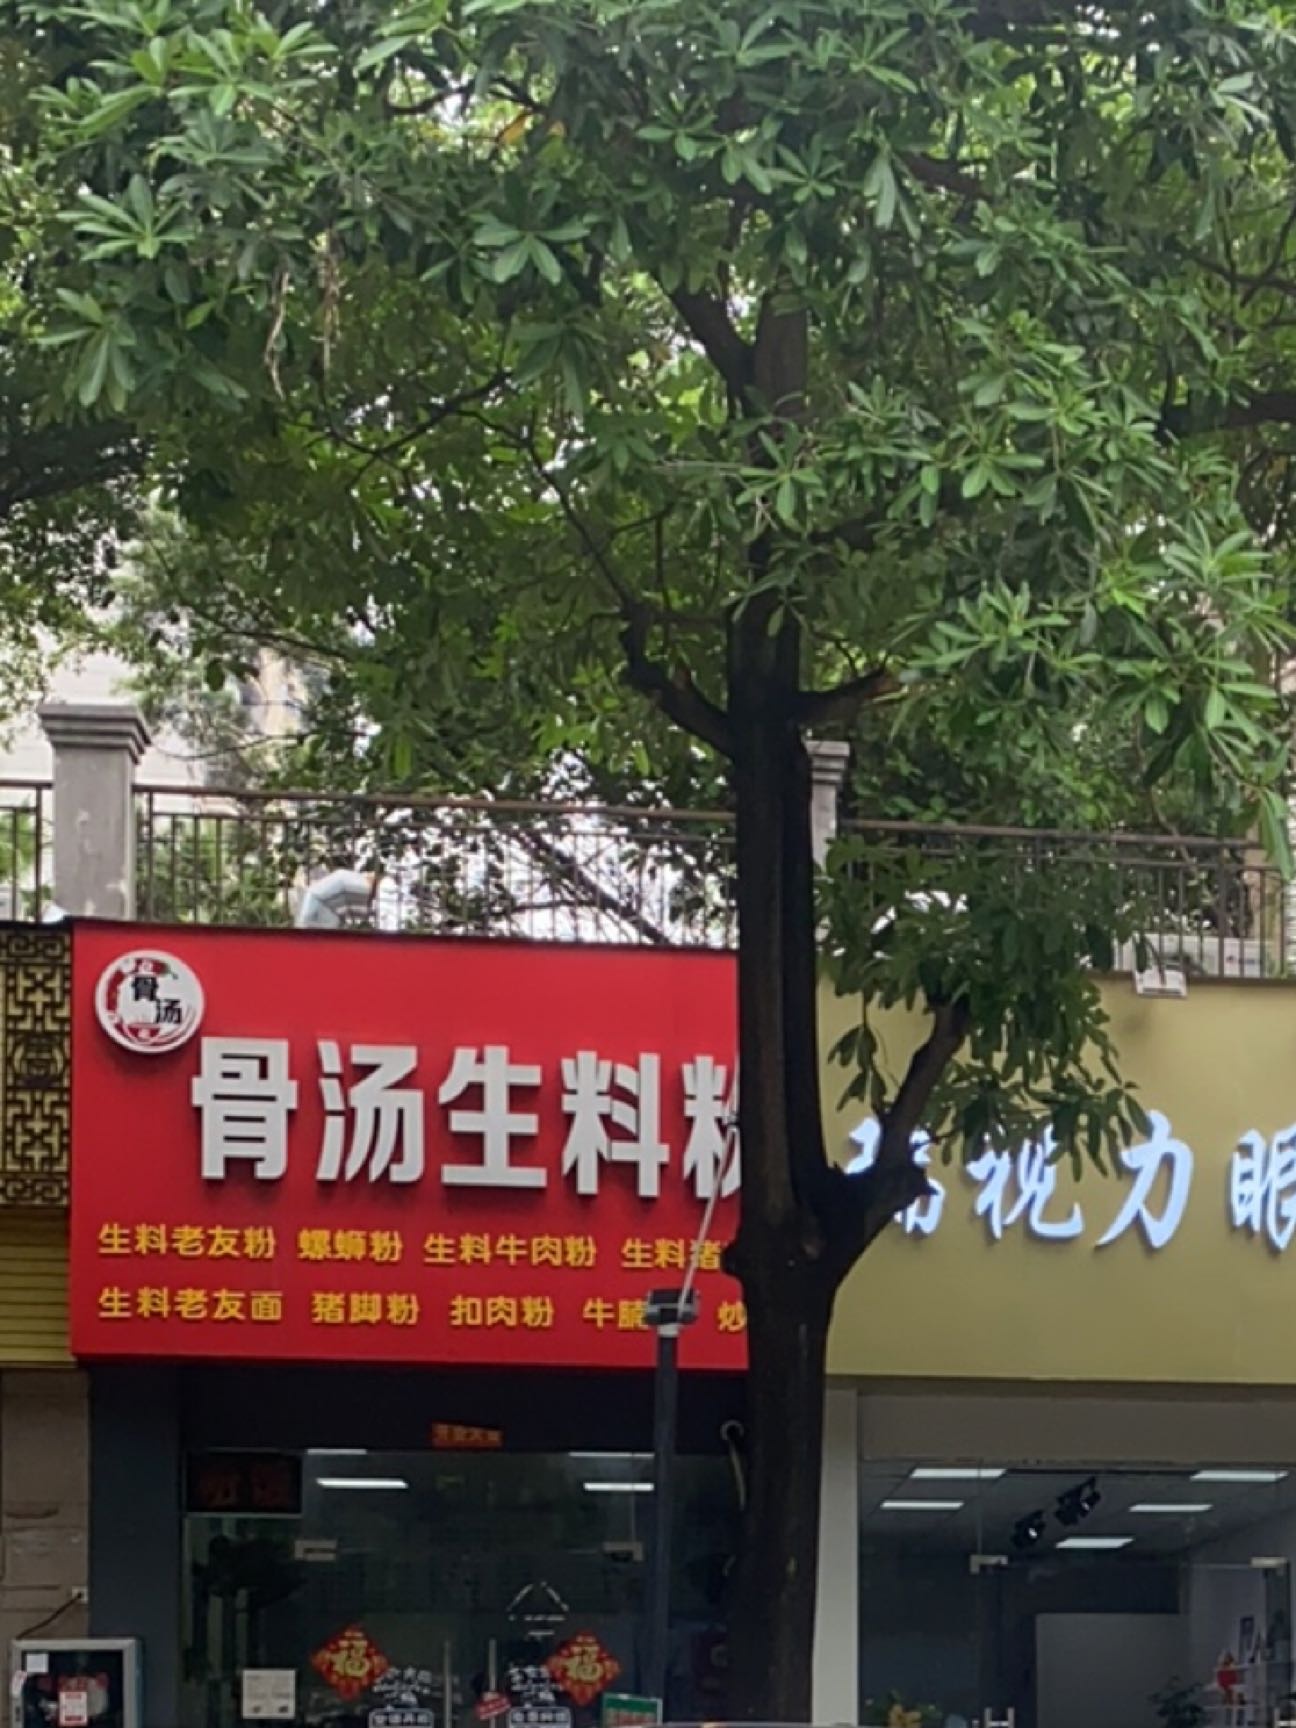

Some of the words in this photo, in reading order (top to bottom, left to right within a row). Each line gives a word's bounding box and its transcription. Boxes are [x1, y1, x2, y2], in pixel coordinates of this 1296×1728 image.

[98, 1222, 276, 1260] 生料老友粉
[298, 1228, 402, 1262] 螺蛳粉
[423, 1233, 597, 1267] 生料牛肉粉
[98, 1286, 283, 1321] 生料老友面
[312, 1292, 419, 1325] 猪脚粉
[450, 1295, 554, 1328] 扣肉粉
